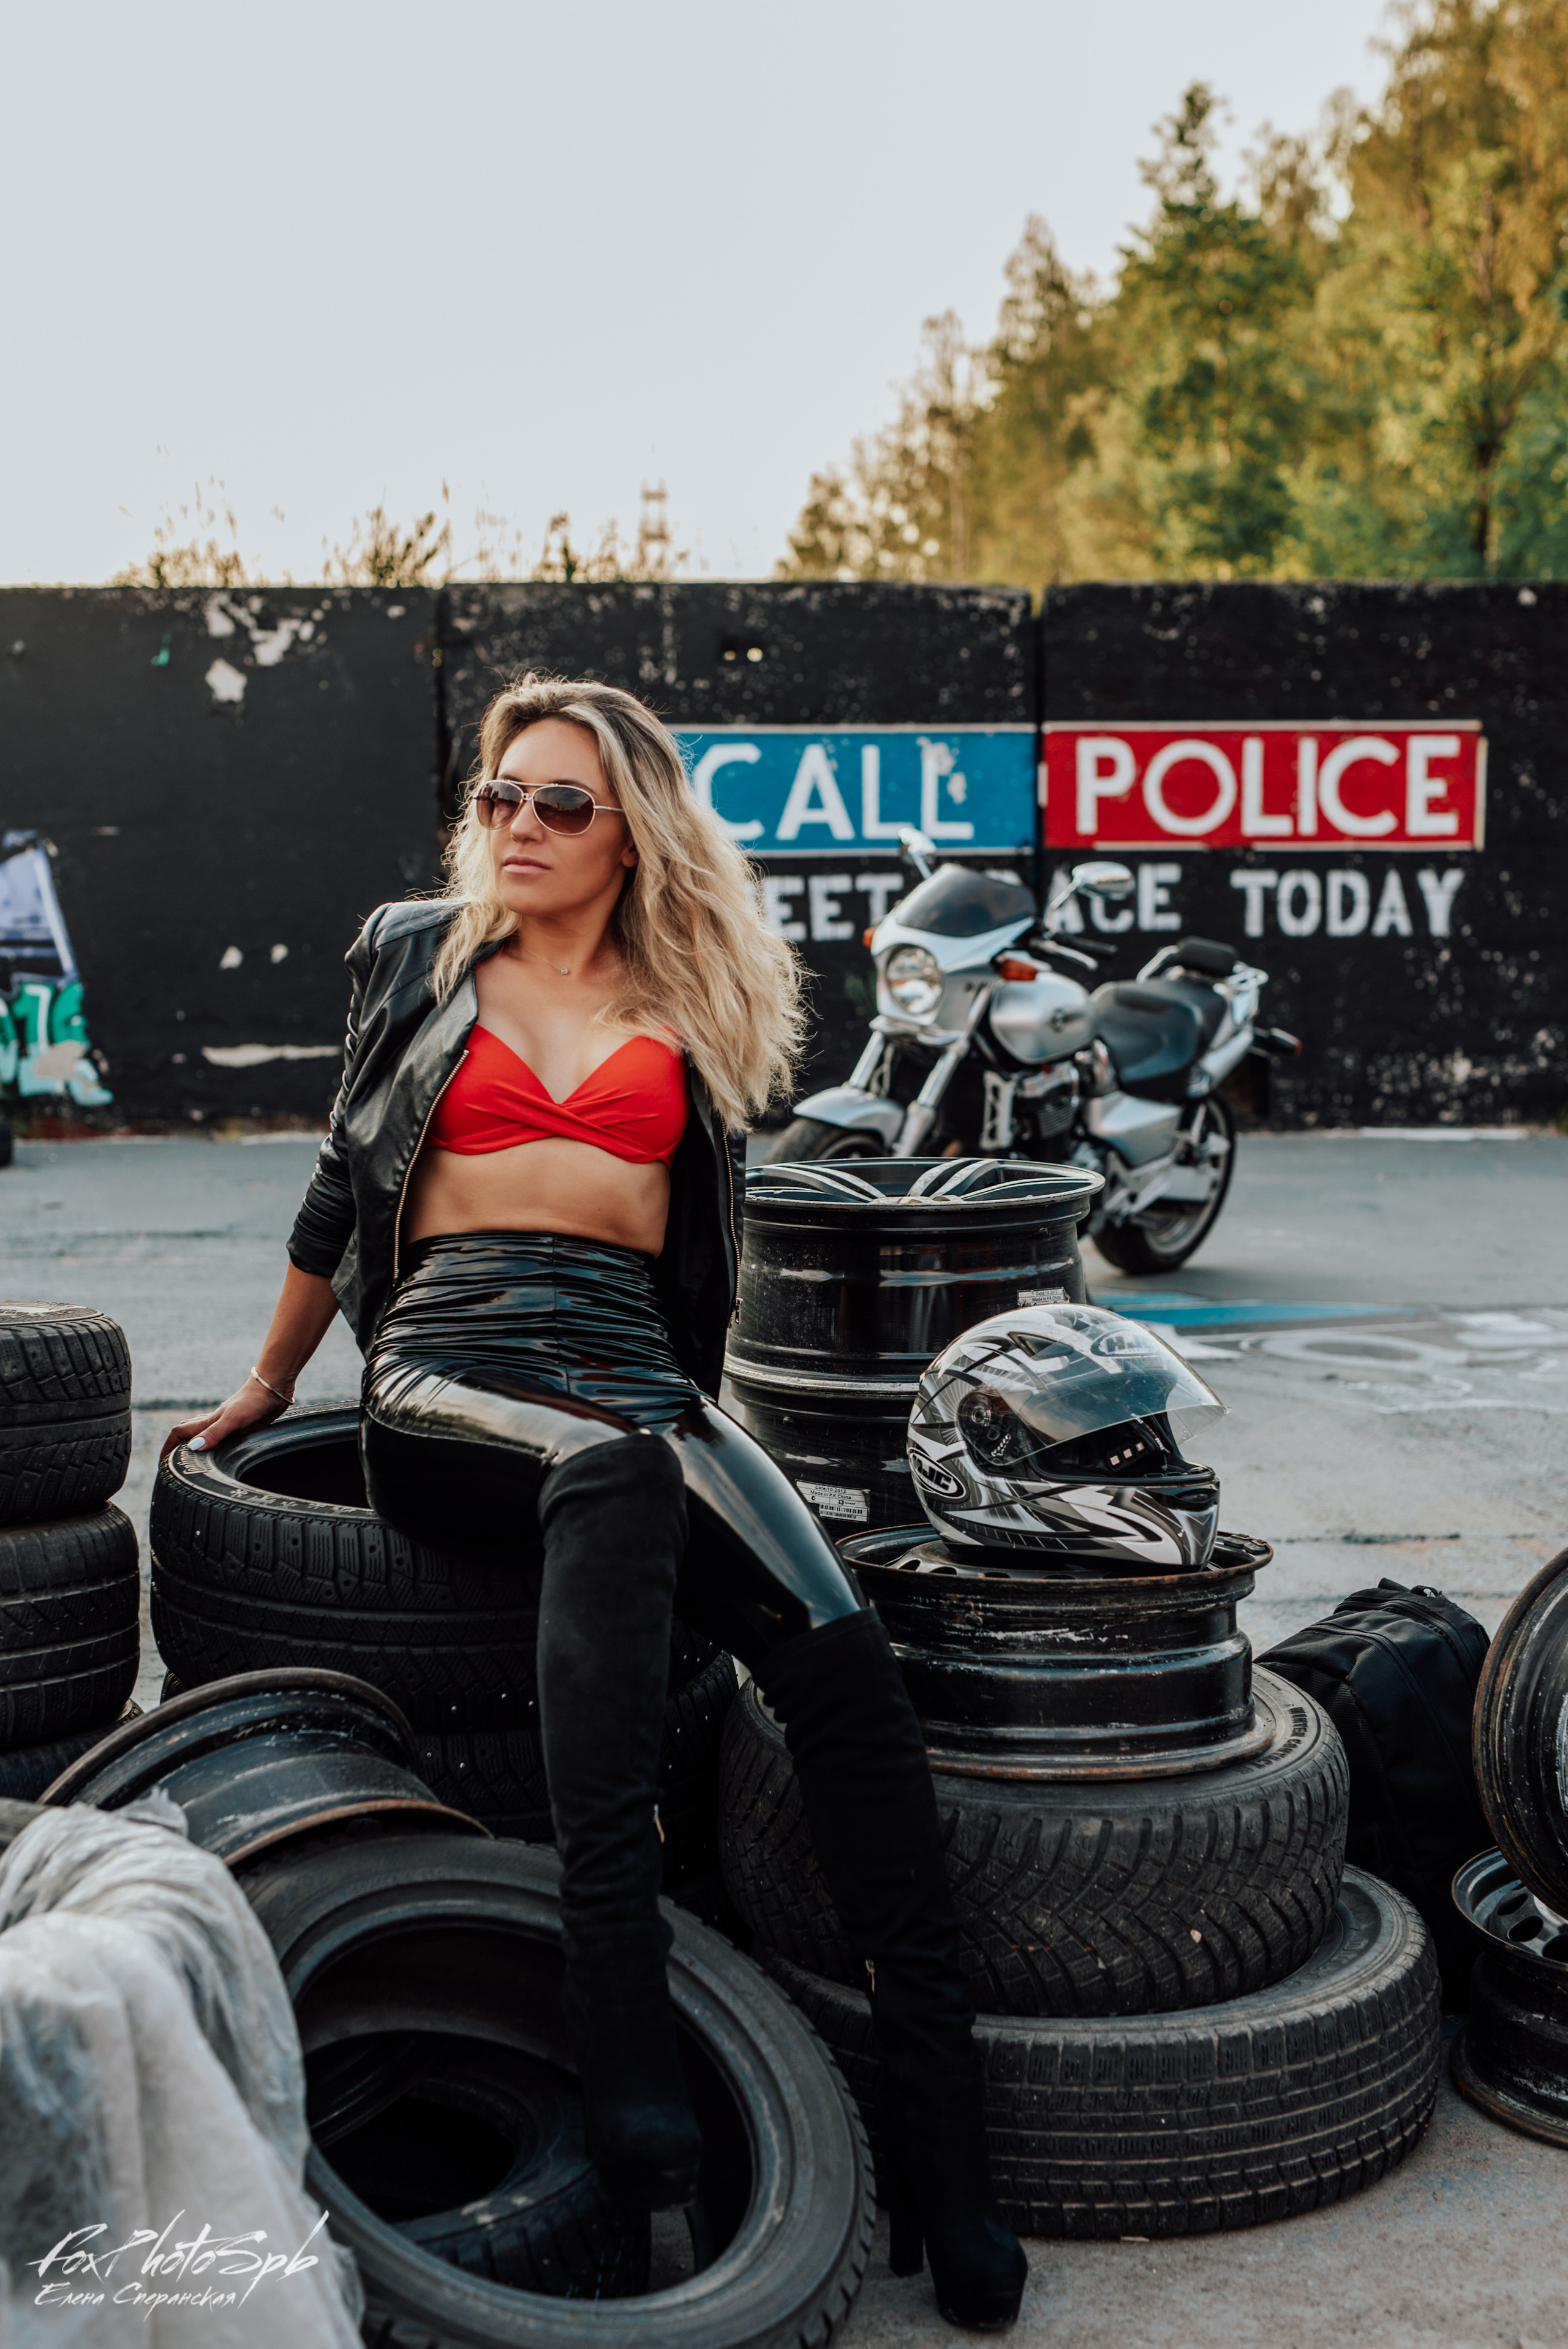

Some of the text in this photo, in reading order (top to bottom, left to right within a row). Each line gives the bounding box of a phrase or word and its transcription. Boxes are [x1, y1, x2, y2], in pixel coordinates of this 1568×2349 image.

[692, 736, 1461, 840] CALL POLICE
[746, 863, 1466, 942] EET ACE TODAY
[1288, 1706, 1308, 1738] WINTER
